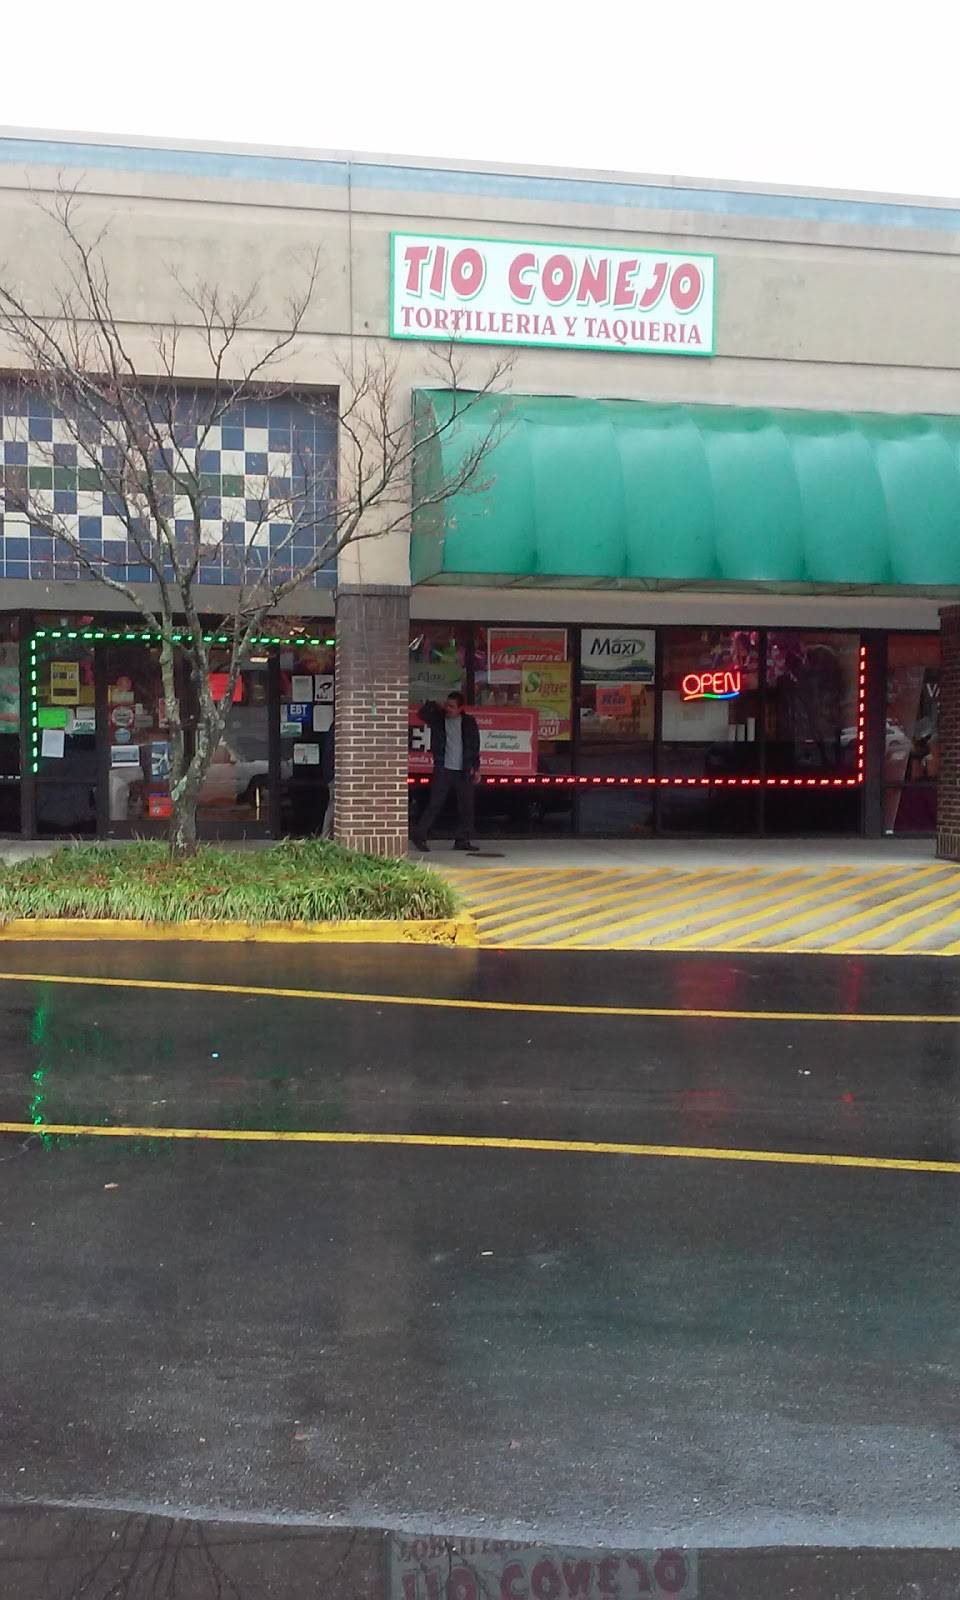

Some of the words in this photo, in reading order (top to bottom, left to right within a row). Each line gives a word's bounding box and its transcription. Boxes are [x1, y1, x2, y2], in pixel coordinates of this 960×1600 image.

[404, 245, 486, 298] TIO
[508, 252, 703, 311] CONEJO
[401, 306, 556, 336] TORTILLERIA
[563, 316, 578, 337] Y
[585, 318, 702, 346] TAQUERIA
[590, 638, 635, 656] Maxi
[525, 671, 568, 697] Sigue
[682, 671, 741, 695] OPEN
[290, 703, 308, 715] EBT
